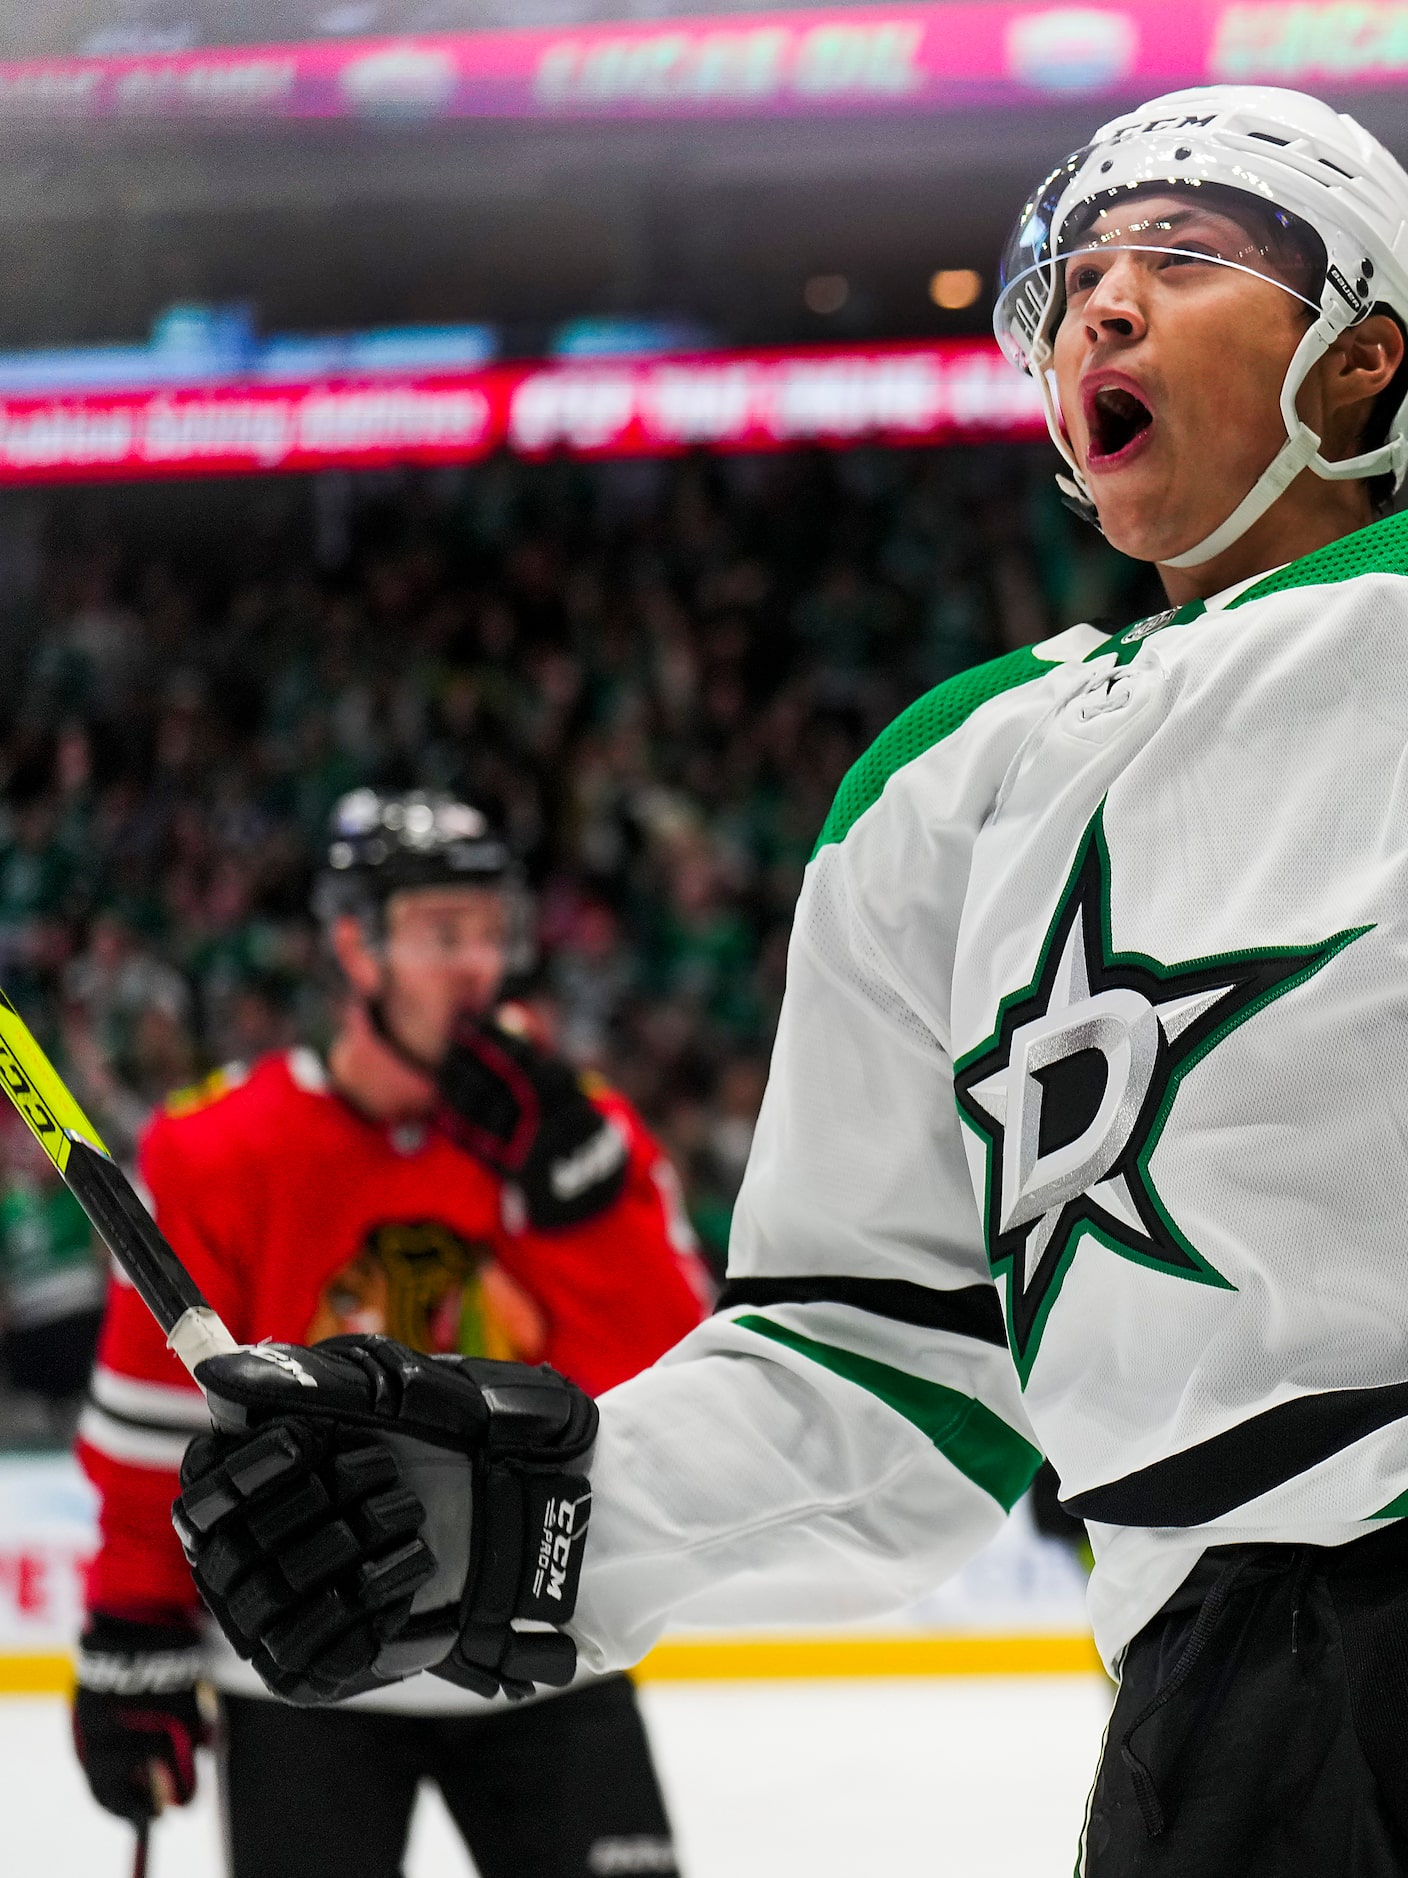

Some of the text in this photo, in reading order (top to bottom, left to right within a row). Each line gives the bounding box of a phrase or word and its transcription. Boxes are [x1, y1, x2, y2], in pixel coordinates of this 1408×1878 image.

[1110, 114, 1219, 146] CCM
[1331, 269, 1360, 308] BAUER
[0, 1046, 56, 1138] CC
[999, 988, 1159, 1236] D
[546, 1499, 576, 1602] CCM
